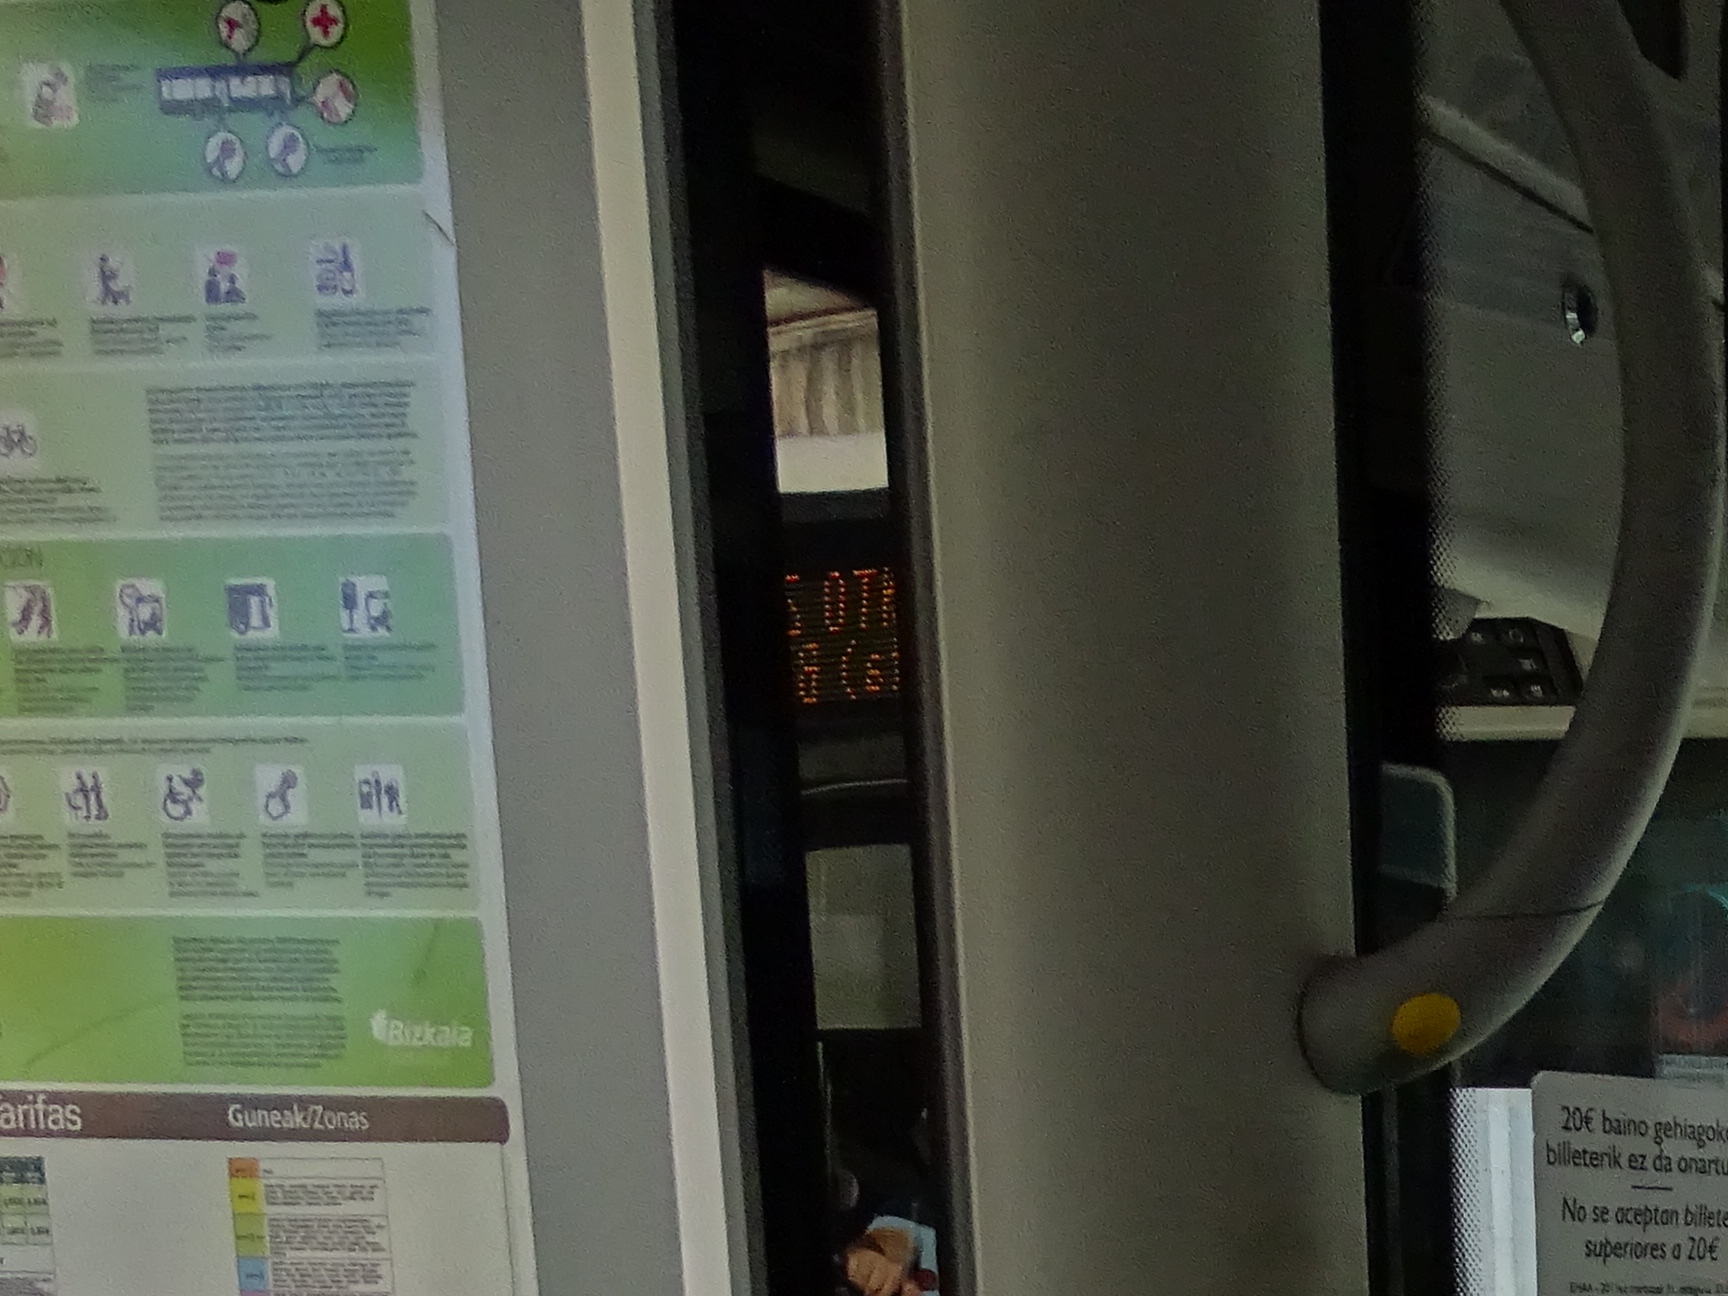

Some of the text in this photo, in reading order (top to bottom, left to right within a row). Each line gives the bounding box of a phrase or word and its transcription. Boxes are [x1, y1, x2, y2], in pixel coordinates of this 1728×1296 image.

[0, 1092, 83, 1131] arifas
[228, 1102, 370, 1132] Guneak/Zonas
[1561, 1105, 1596, 1132] 20€
[1602, 1108, 1648, 1137] baino
[1546, 1140, 1622, 1170] billeterik
[1628, 1153, 1646, 1172] ez
[1653, 1149, 1673, 1173] da
[1562, 1197, 1587, 1223] No
[1592, 1205, 1609, 1222] se
[1615, 1203, 1679, 1232] aceptan
[1585, 1236, 1720, 1266] superiores a 20€
